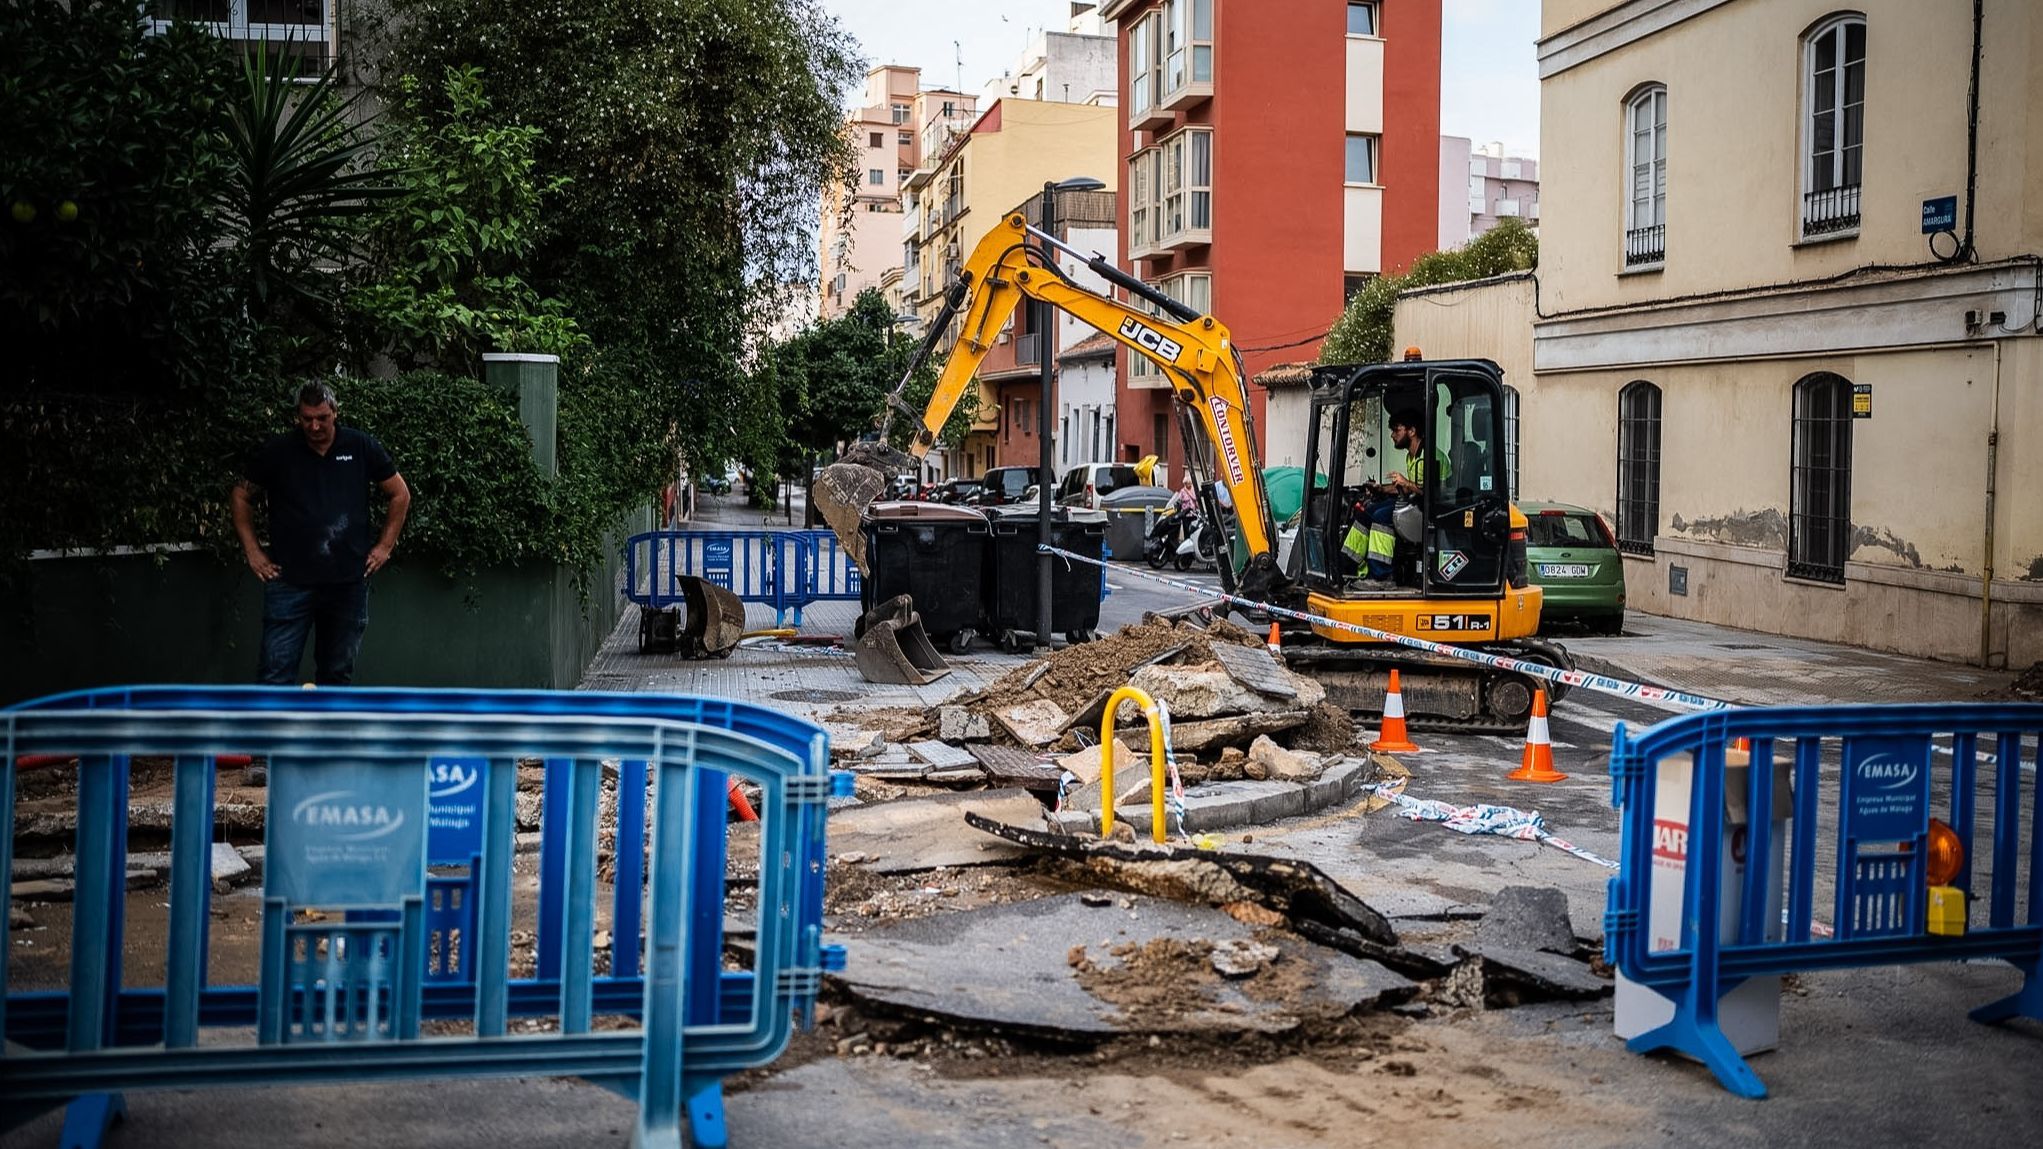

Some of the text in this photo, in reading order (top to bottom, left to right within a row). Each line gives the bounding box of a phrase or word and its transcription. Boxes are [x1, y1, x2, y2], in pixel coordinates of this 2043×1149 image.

[1923, 215, 1952, 226] AMARGURA
[1121, 322, 1181, 361] JCB
[1214, 401, 1244, 482] CONTORVER
[1544, 565, 1567, 575] 0824
[1433, 615, 1463, 630] 51
[1470, 621, 1490, 630] R-1
[1864, 763, 1910, 778] EMASA
[306, 805, 390, 825] EMASA
